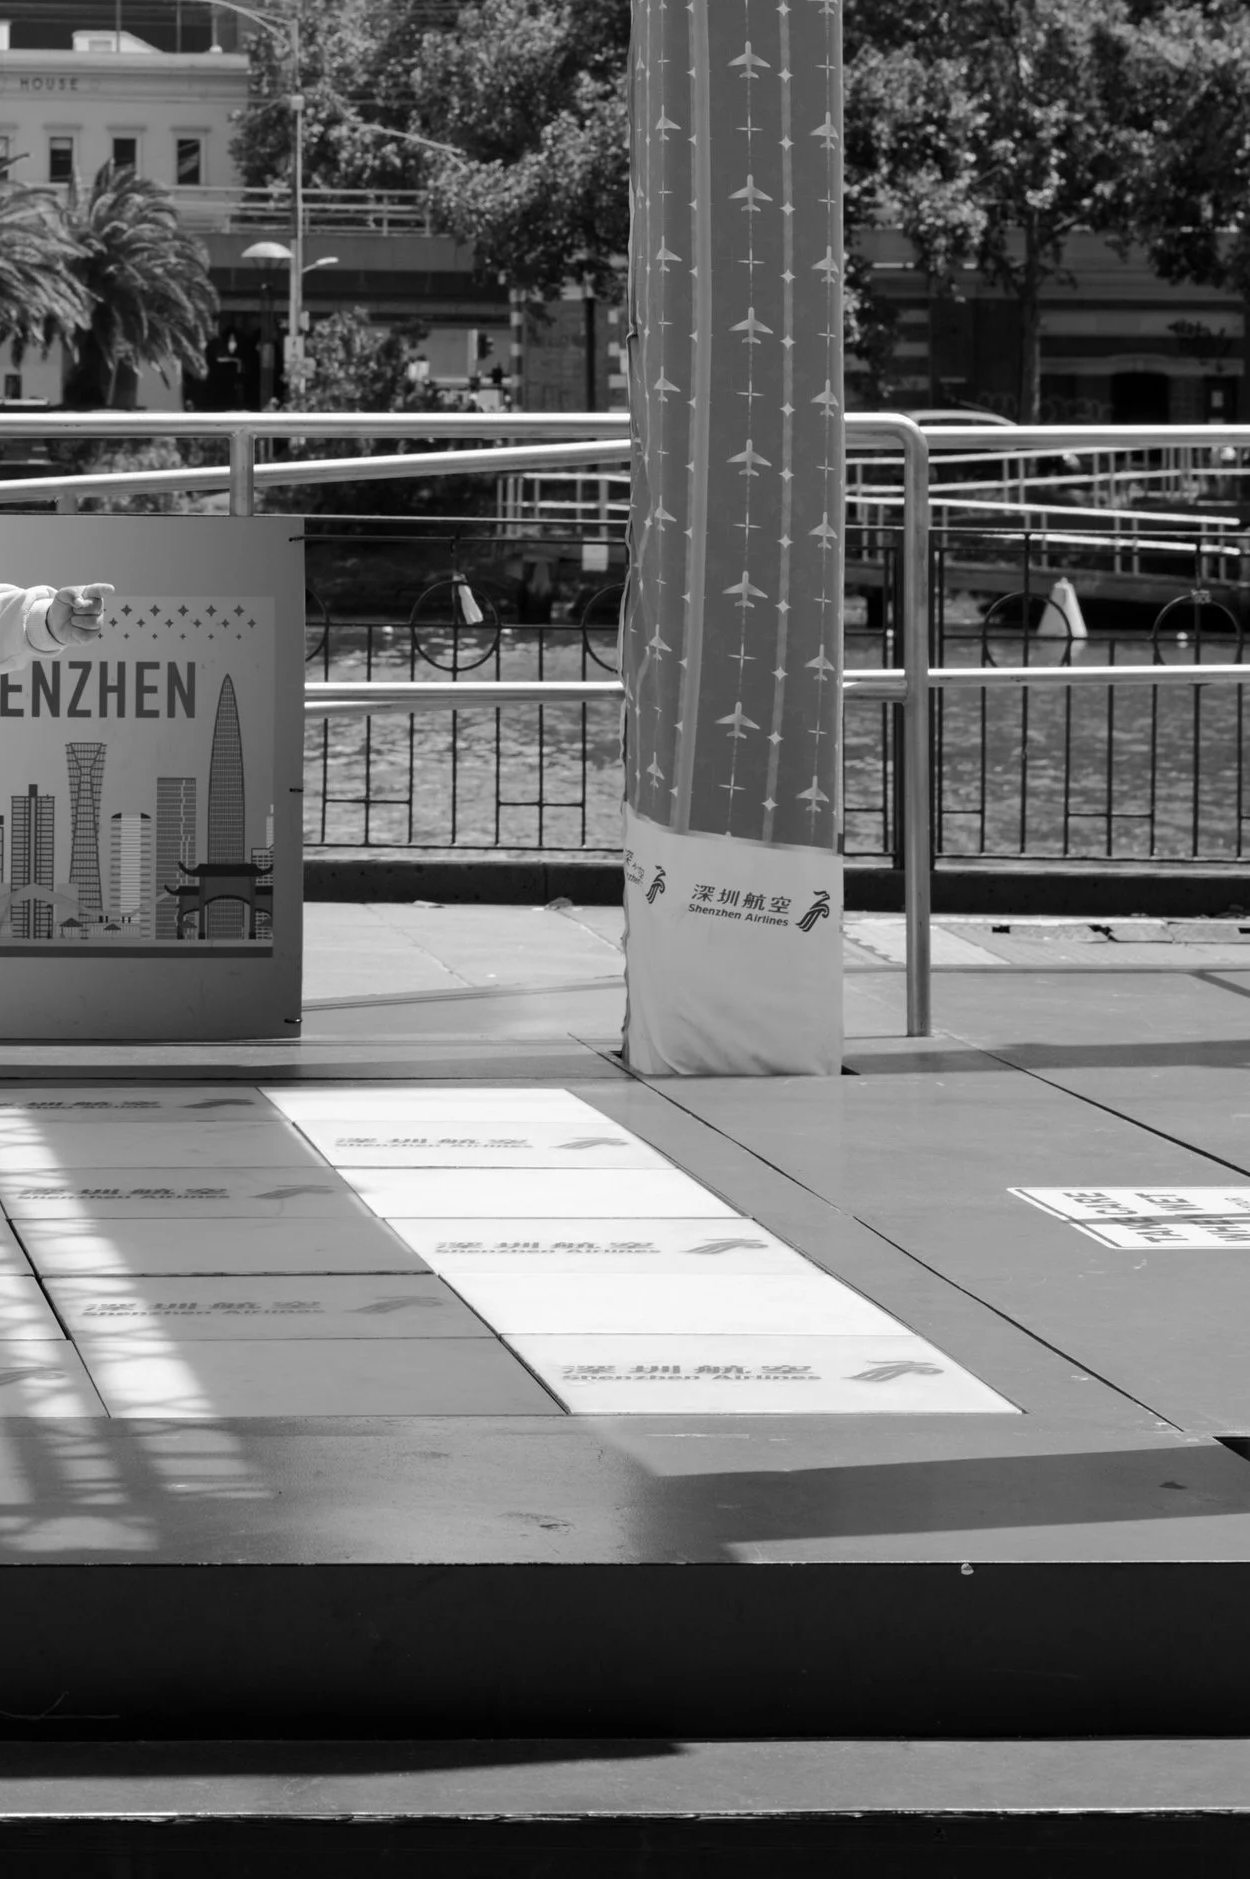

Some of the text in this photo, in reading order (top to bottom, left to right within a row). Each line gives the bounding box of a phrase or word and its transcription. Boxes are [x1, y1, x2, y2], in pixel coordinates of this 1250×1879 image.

[19, 76, 80, 92] HOUSE
[691, 883, 792, 915] 深圳航空
[688, 903, 789, 927] Shenzhen Airlines
[562, 1365, 815, 1374] 深圳航空
